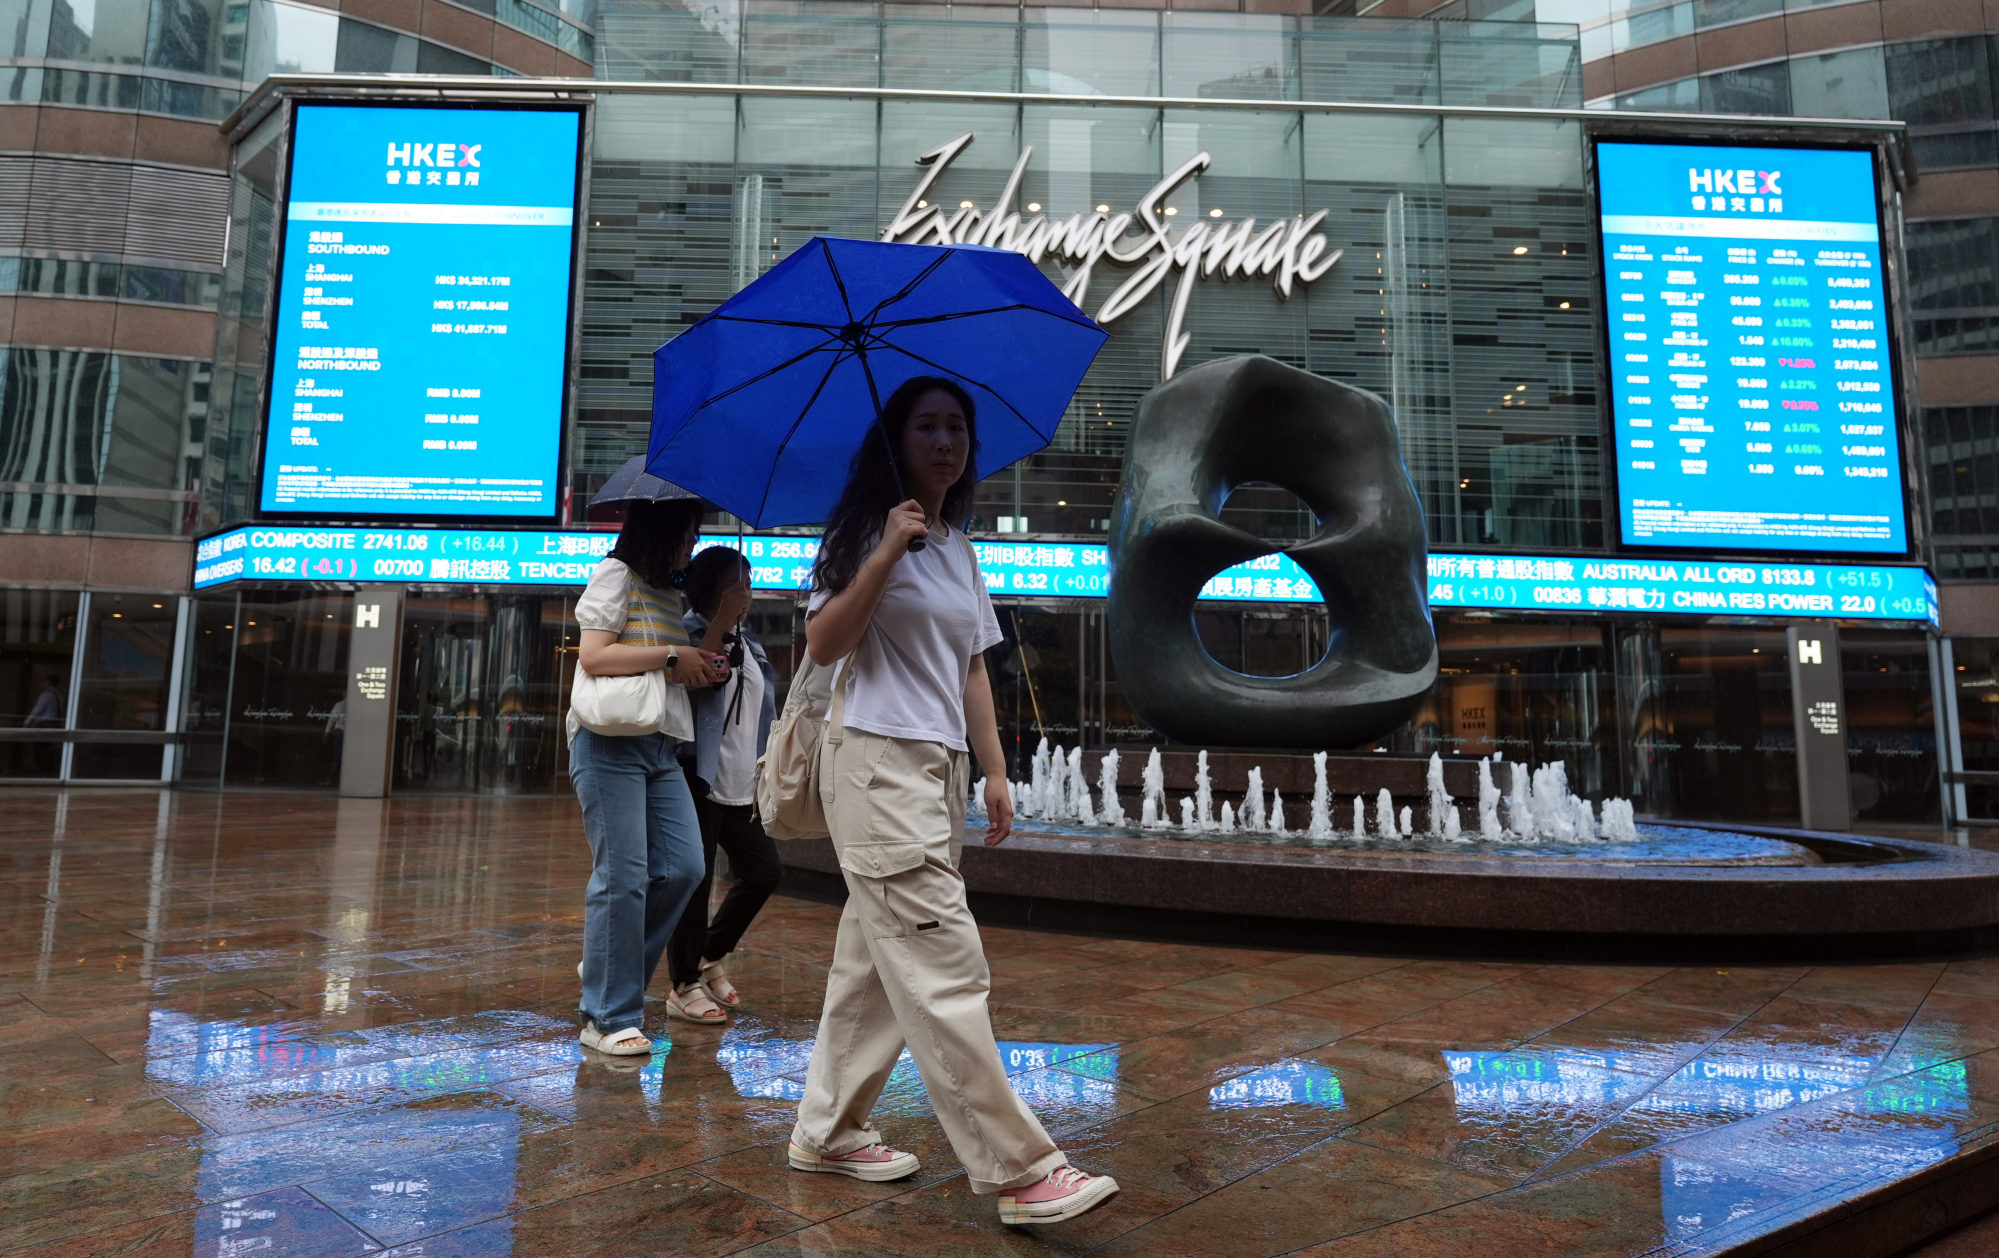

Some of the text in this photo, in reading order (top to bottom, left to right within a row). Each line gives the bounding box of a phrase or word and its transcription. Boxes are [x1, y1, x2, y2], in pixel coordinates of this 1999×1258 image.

[386, 142, 482, 167] HKEX
[1689, 168, 1782, 194] HKEX
[308, 244, 390, 255] SOUTHBOUND
[881, 131, 1344, 381] Exchange Square
[305, 273, 353, 282] SHANGHAI
[303, 297, 353, 305] SHENZHEN
[302, 320, 329, 329] TOTAL
[298, 360, 381, 370] NORTHBOUND
[295, 388, 343, 397] SHANGHAI
[293, 413, 344, 421] SHENZHEN
[291, 437, 319, 445] TOTAL
[223, 533, 247, 552] KOREA
[251, 532, 355, 550] COMPOSITE
[363, 534, 428, 550] 2741.06
[752, 542, 763, 556] B
[210, 558, 244, 579] OVERSEAS
[252, 557, 296, 573] 16.42
[375, 560, 423, 576] 00700
[429, 559, 511, 580] 騰訊控股
[1583, 565, 1678, 582] AUSTRALIA
[1684, 566, 1715, 582] ALL
[1718, 567, 1755, 583] ORD
[1762, 569, 1814, 585] 8133.8
[1013, 573, 1047, 589] 6.32
[1534, 587, 1581, 604] 00836
[1587, 587, 1665, 608] 華潤電力
[1673, 592, 1729, 608] CHINA
[1731, 592, 1766, 609] RES
[1769, 593, 1832, 610] POWER
[1841, 596, 1875, 611] 22.0
[356, 605, 380, 628] H
[1798, 640, 1822, 664] H
